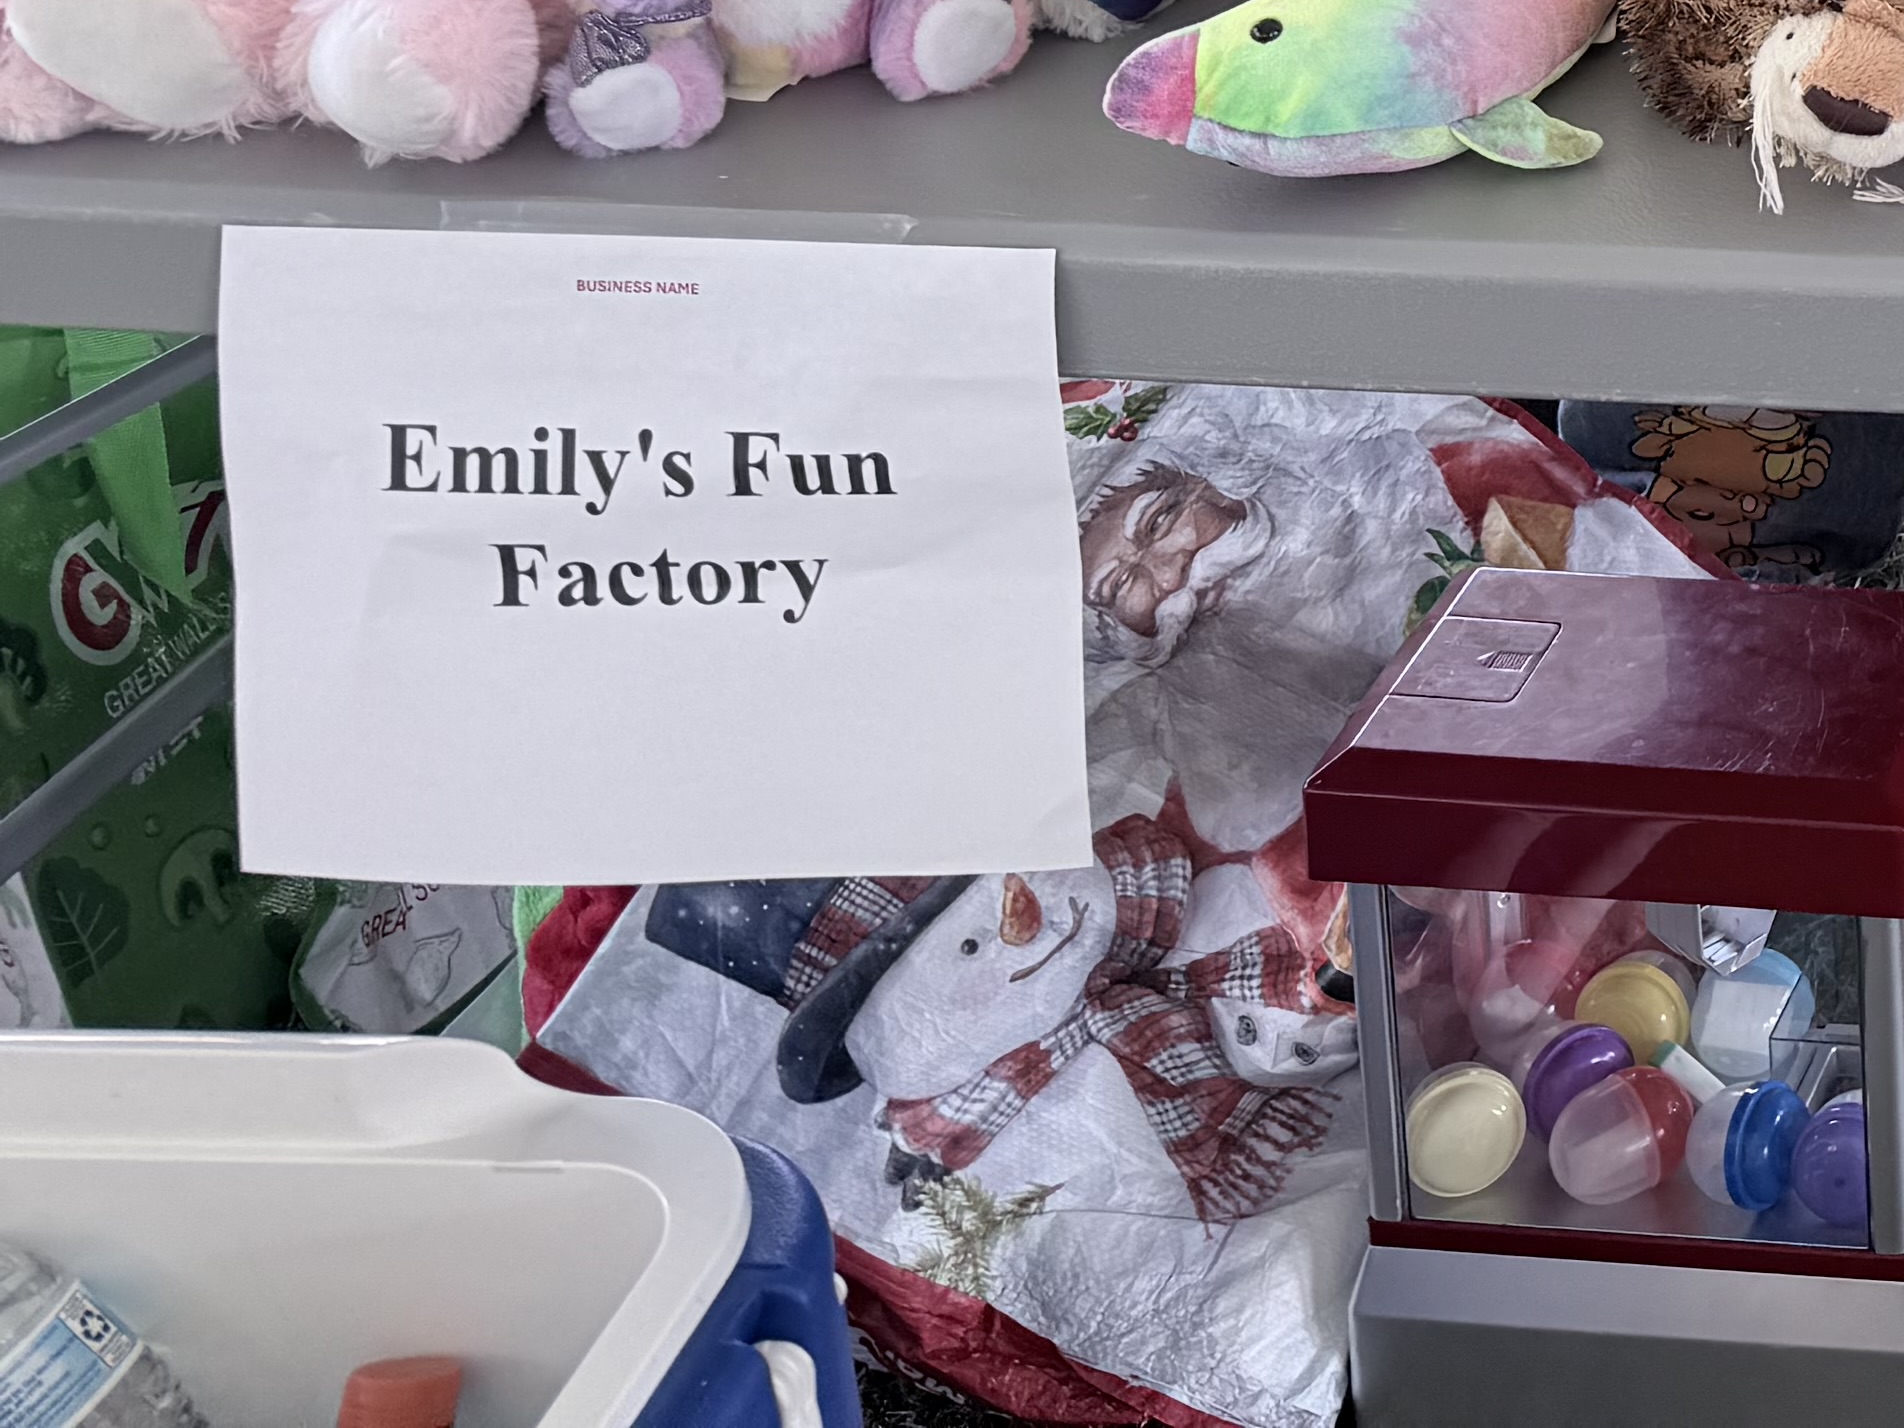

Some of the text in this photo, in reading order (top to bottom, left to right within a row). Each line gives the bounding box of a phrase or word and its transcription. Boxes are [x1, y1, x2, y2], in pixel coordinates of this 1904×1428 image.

[576, 279, 700, 295] BUSINESS NAME
[381, 422, 899, 516] Emily's Fun
[488, 543, 830, 624] Factory
